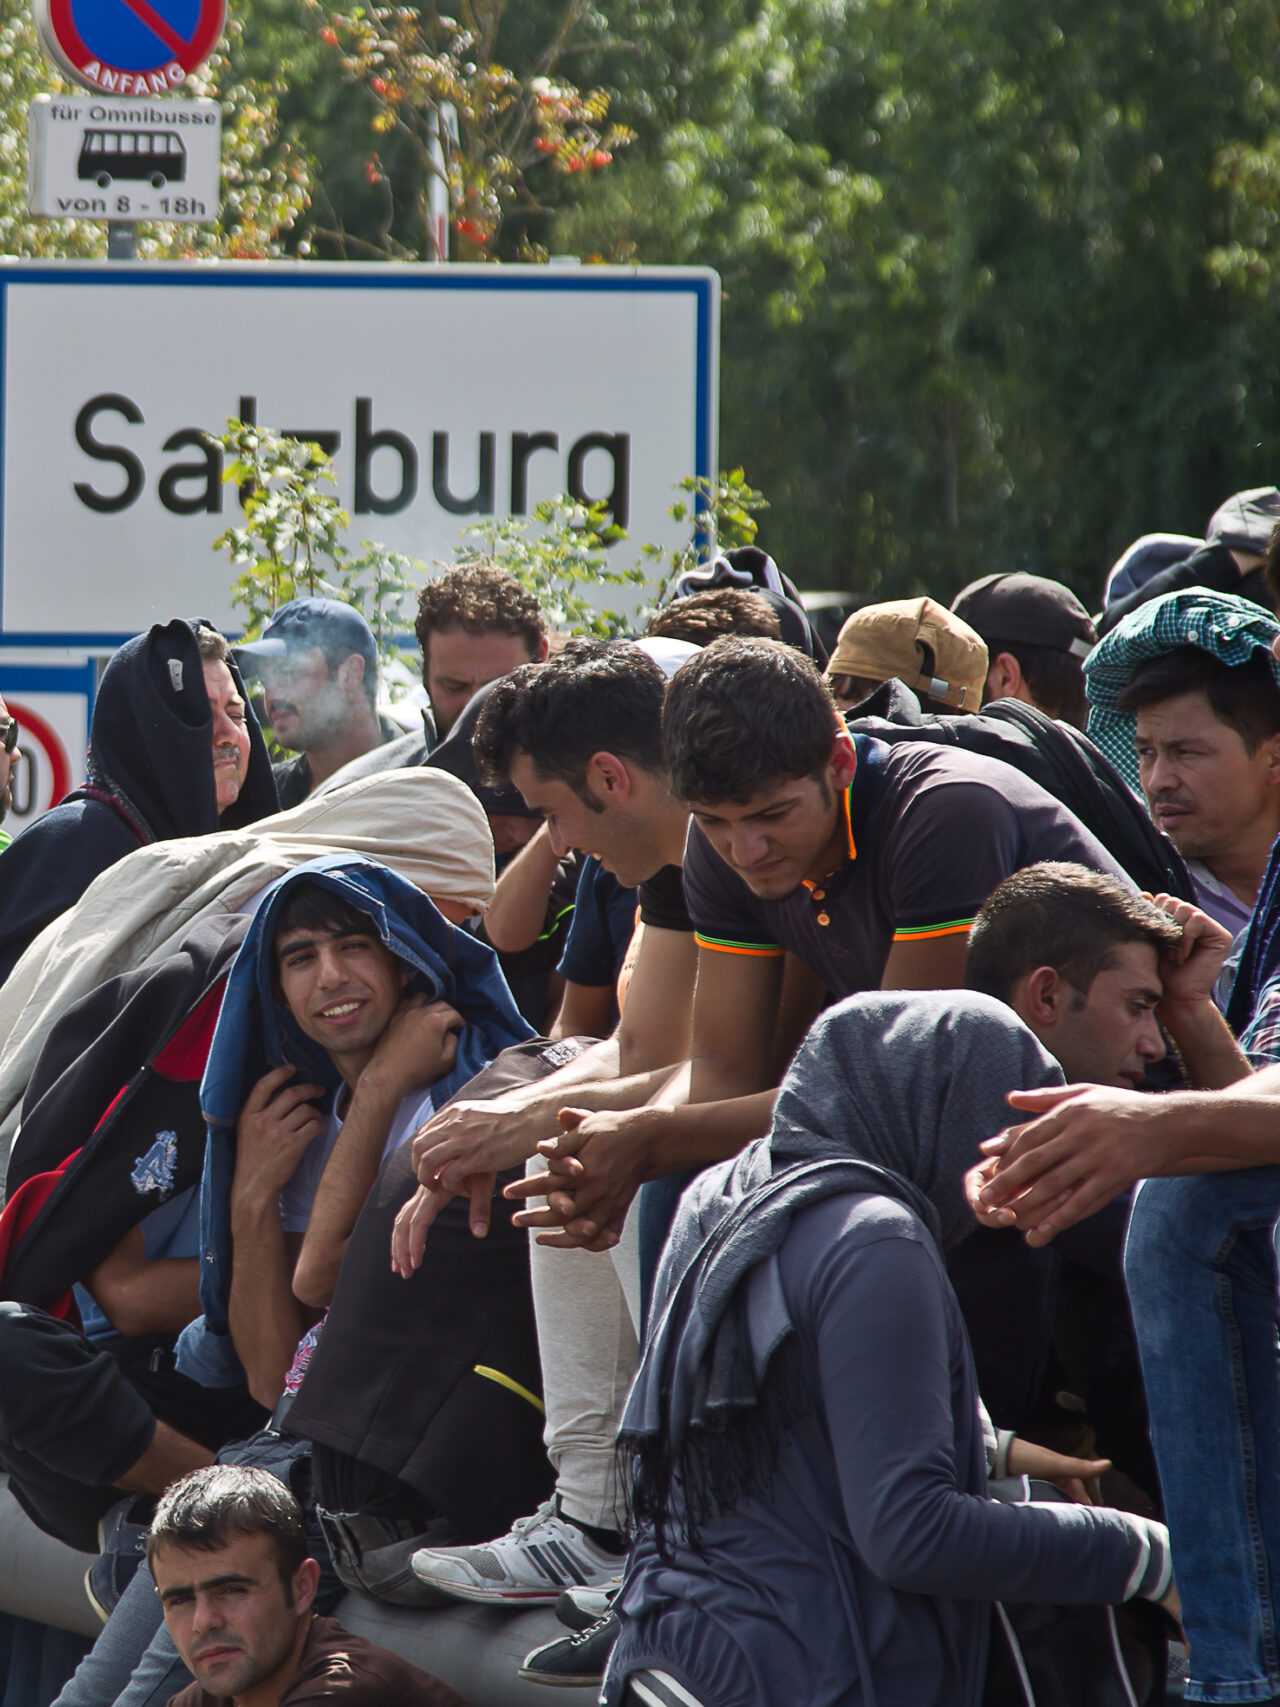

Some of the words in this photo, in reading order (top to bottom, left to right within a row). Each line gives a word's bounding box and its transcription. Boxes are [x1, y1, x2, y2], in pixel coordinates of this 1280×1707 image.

[82, 60, 186, 95] ANFANG
[51, 104, 82, 121] für
[89, 105, 217, 125] Omnibusse
[57, 197, 107, 213] von
[116, 196, 131, 213] 8
[160, 196, 207, 216] 18h
